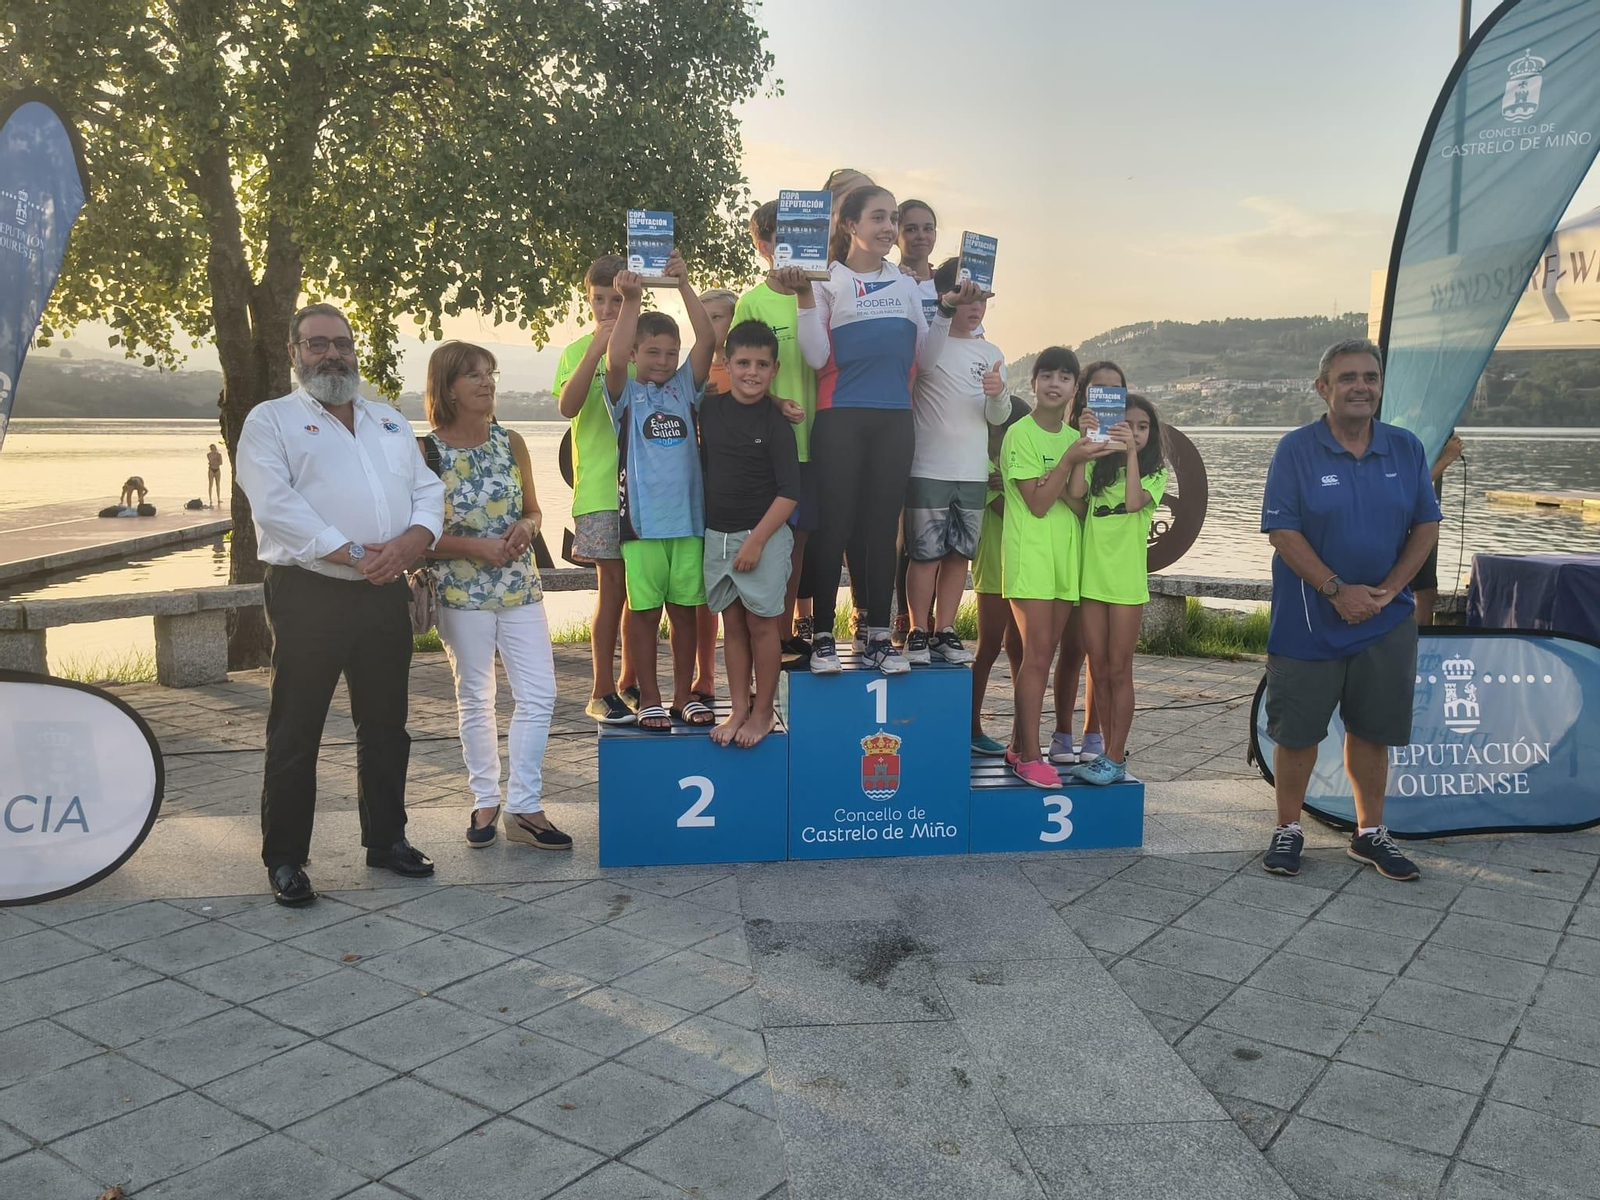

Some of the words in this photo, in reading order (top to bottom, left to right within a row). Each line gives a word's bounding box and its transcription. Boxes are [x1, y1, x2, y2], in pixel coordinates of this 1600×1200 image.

[1479, 125, 1537, 140] CONCELLO
[1540, 123, 1556, 133] DE
[1441, 139, 1515, 158] CASTRELO
[1519, 137, 1541, 151] DE
[1545, 130, 1592, 148] MIÑO
[780, 199, 824, 208] DEPUTACIÓN
[781, 192, 800, 200] COPA
[629, 218, 668, 226] DEPUTACIÓN
[856, 298, 902, 309] RODEIRA
[866, 678, 888, 724] 1
[1388, 736, 1551, 766] EPUTACIÓN
[1397, 772, 1530, 797] OURENSE
[677, 775, 715, 828] 2
[834, 807, 902, 822] Concello
[908, 806, 926, 820] de
[1039, 794, 1074, 842] 3
[801, 825, 878, 843] Castrelo
[882, 823, 904, 840] de
[910, 821, 958, 839] Miño
